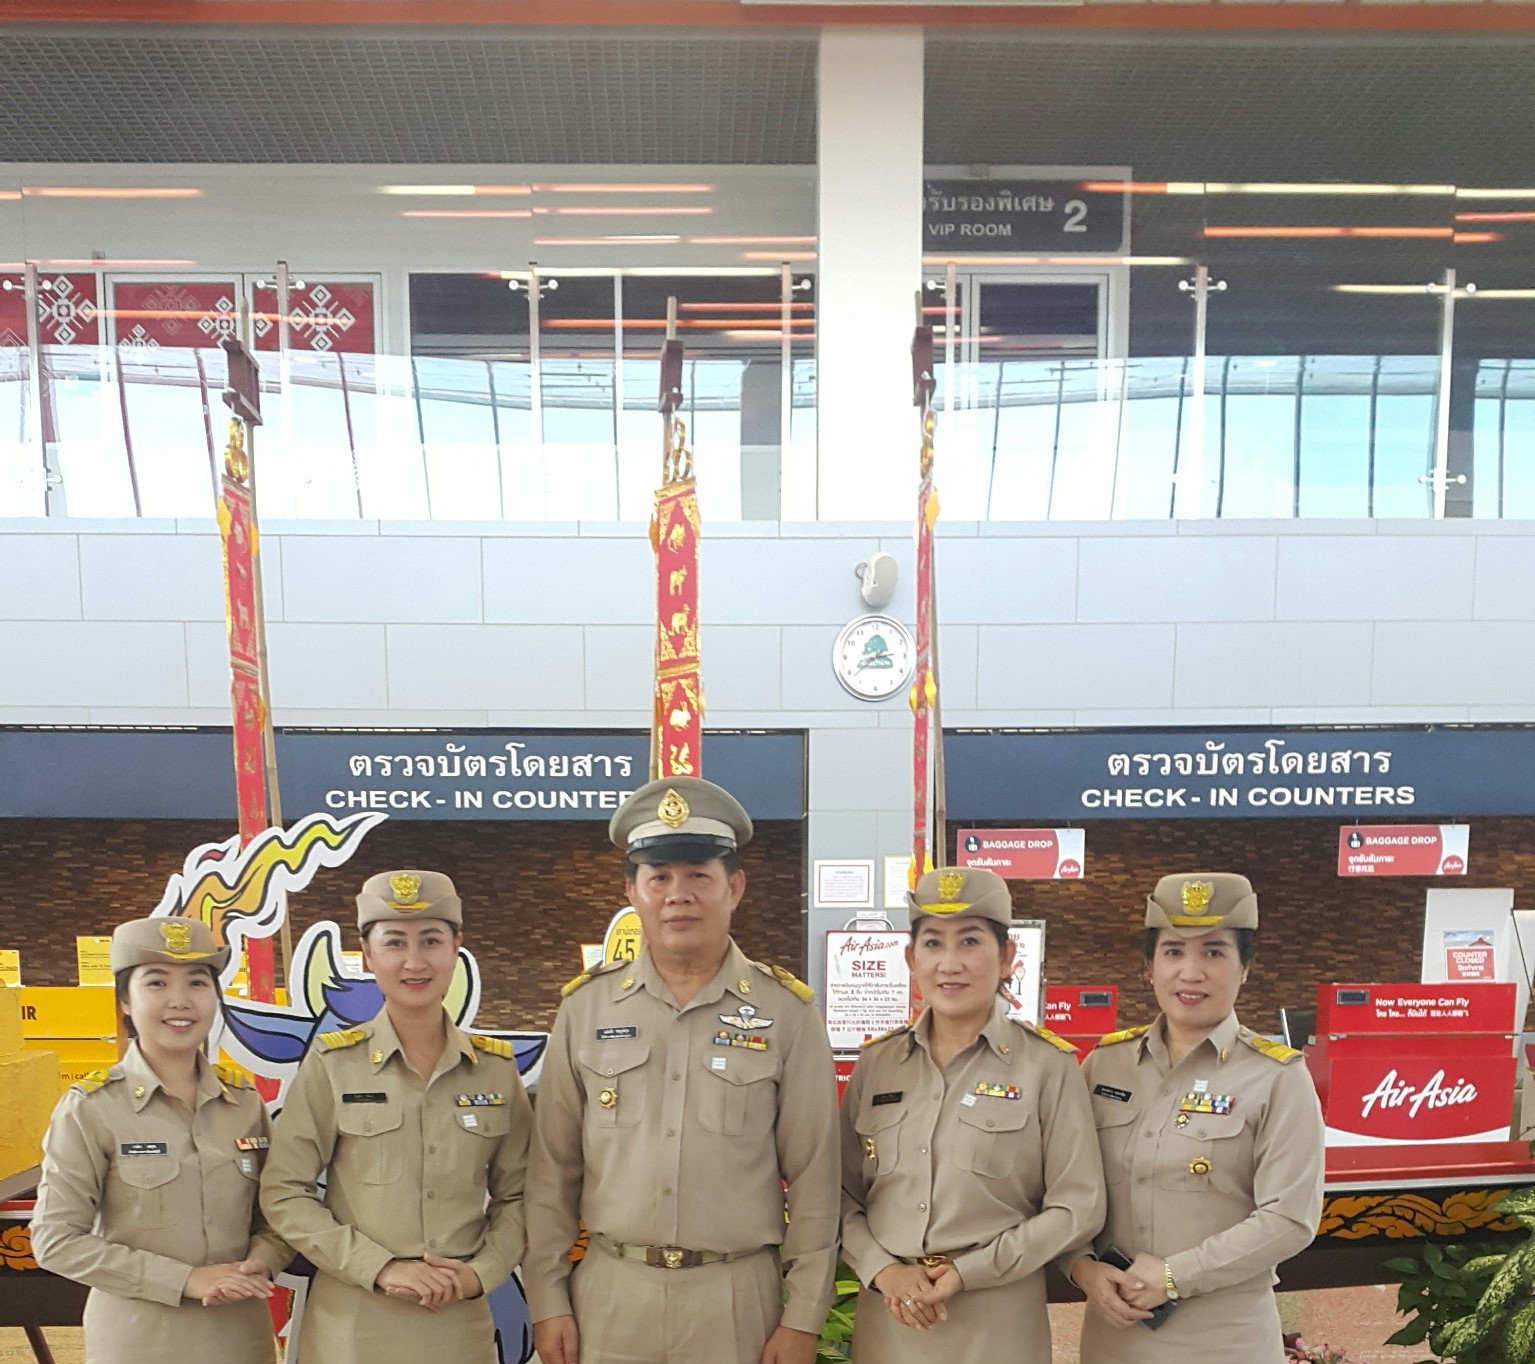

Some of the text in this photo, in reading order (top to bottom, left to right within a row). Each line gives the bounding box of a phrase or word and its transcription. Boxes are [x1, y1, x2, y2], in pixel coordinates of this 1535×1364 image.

[1063, 200, 1088, 232] 2
[928, 223, 1012, 236] VIP ROOM
[349, 743, 633, 777] ตรวจบัตรโดยสาร
[1107, 739, 1392, 776] ตรวจบัตรโดยสาร
[325, 790, 431, 809] CHECK
[455, 790, 483, 809] IN
[1081, 788, 1187, 808] CHECK
[1209, 787, 1238, 807] IN
[1248, 785, 1415, 806] COUNTERS
[982, 840, 1053, 849] BAGGAGE DROP
[1365, 836, 1437, 845] BAGGAGE DROP
[612, 938, 635, 961] 45
[851, 960, 887, 971] SIZE
[1058, 1001, 1072, 1011] Fly
[1375, 997, 1469, 1008] Now Everyone Can Fly
[21, 1005, 37, 1020] IR
